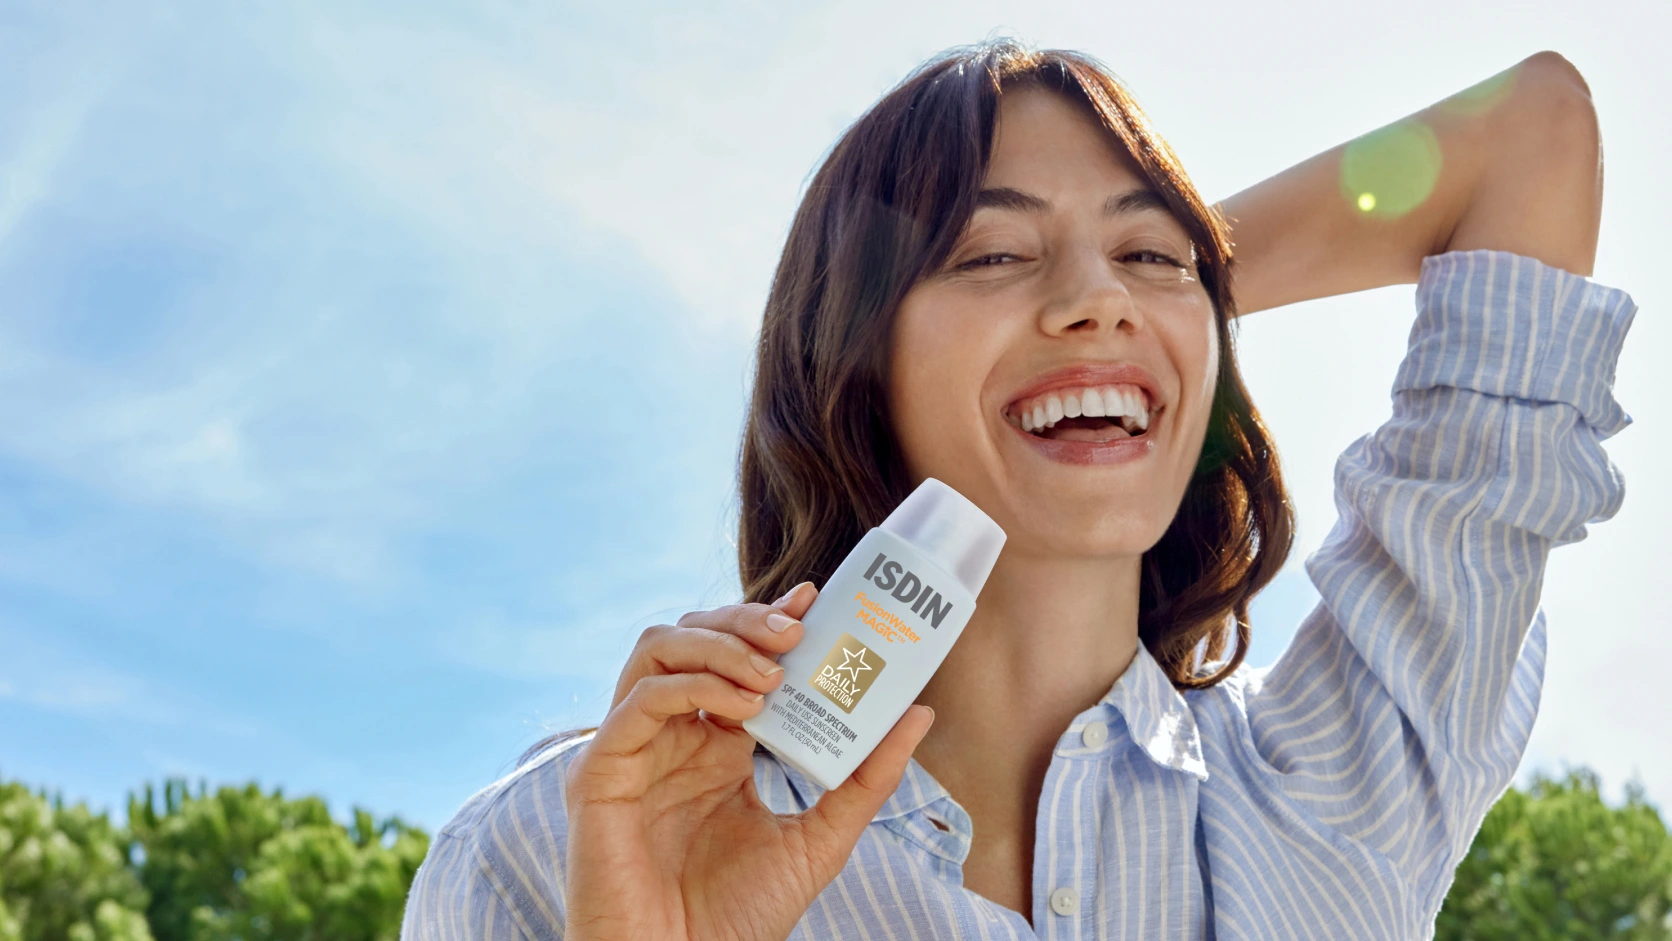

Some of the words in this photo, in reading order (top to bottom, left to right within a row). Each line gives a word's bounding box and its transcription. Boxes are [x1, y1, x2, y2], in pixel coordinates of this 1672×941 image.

[863, 552, 953, 630] ISDIN
[854, 591, 921, 644] FusionWater
[814, 674, 854, 708] PROTECTION
[821, 664, 861, 696] DAILY
[771, 702, 787, 717] WITH
[785, 712, 828, 746] MEDITERRANEAN
[825, 742, 844, 759] ALGAE
[781, 684, 796, 696] SPF
[794, 692, 805, 703] 40
[803, 698, 827, 717] BROAD
[825, 713, 858, 742] SPECTRUM
[781, 721, 791, 731] 1.7
[788, 726, 796, 736] FL
[785, 700, 804, 715] DAILY
[801, 710, 814, 722] USE
[811, 717, 842, 743] SUNSCREEN
